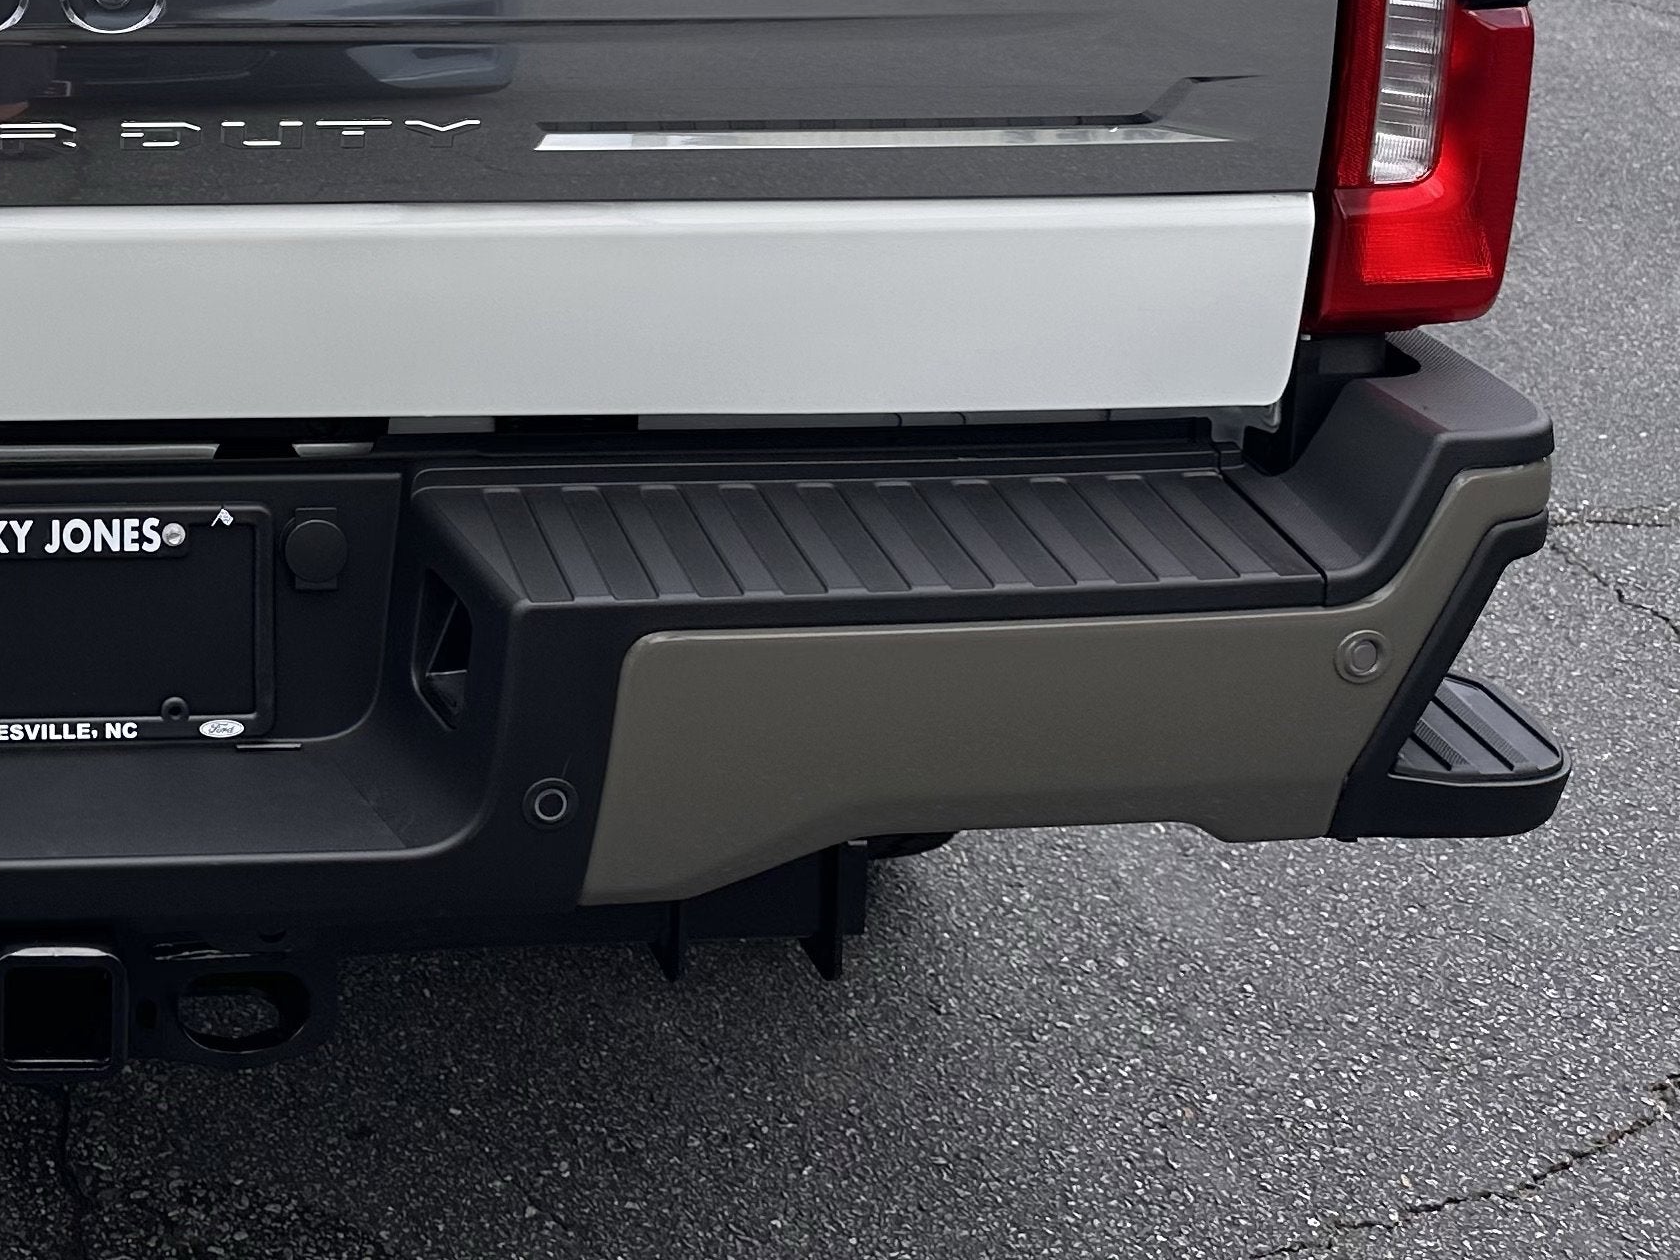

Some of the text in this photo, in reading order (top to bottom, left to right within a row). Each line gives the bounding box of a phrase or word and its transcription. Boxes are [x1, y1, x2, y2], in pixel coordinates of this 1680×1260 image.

[119, 119, 482, 151] DUTY
[43, 517, 163, 553] JONES
[104, 721, 139, 739] NC
